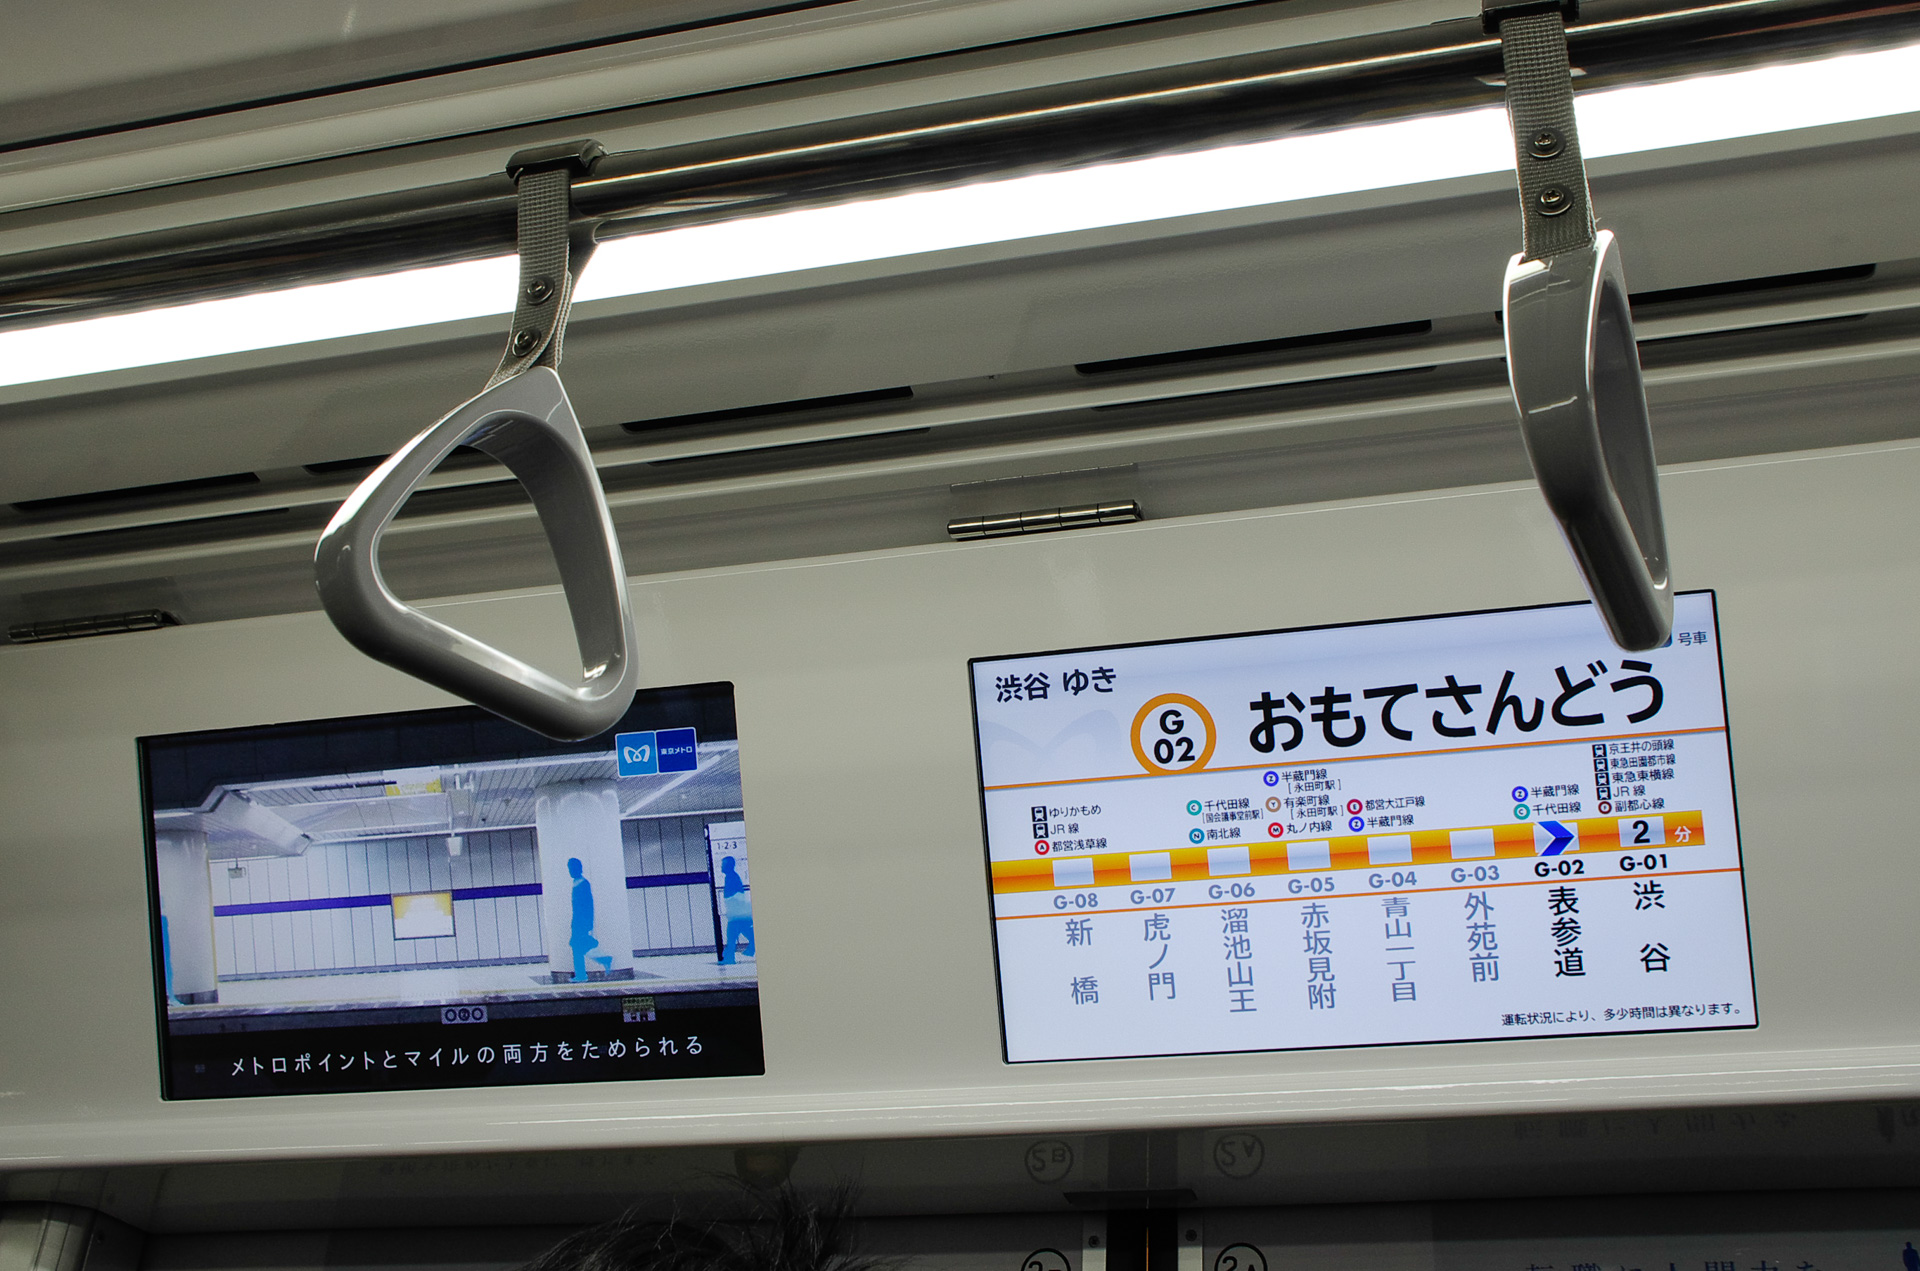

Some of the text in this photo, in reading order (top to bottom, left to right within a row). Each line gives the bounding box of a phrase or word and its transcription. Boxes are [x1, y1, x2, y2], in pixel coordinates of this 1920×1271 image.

[1678, 631, 1708, 646] 号車
[995, 666, 1117, 703] 渋谷 ゆき
[1249, 659, 1664, 753] おもてさんどう
[1159, 709, 1185, 735] G
[660, 746, 692, 755] 東京メトロ
[1153, 737, 1196, 764] 02
[1609, 738, 1674, 755] 京王井の頭線
[1610, 753, 1676, 769] 東急田園都市線
[1281, 768, 1328, 783] 半蔵門線
[1611, 768, 1675, 784] 東急東横線
[1530, 783, 1580, 798] 半蔵門線
[1612, 784, 1646, 798] JR 線
[1204, 797, 1250, 812] 千代田線
[1283, 794, 1330, 809] 有楽町線
[1365, 795, 1426, 812] 都営大江戸線
[1532, 801, 1581, 816] 千代田線
[1614, 797, 1665, 813] 副都心線
[1049, 804, 1102, 818] ゆりかもめ
[1050, 822, 1080, 835] JR 線
[1286, 820, 1333, 834] 丸ノ内線
[1366, 814, 1415, 829] 半蔵門線
[1206, 827, 1242, 841] 南北線
[1631, 820, 1692, 844] 2 分
[1052, 837, 1108, 853] 都営浅草線
[1534, 859, 1585, 877] G-02
[1619, 853, 1668, 872] G-01
[1368, 871, 1417, 889] G-04
[1450, 865, 1500, 883] G-03
[1208, 883, 1256, 900] G-06
[1287, 877, 1335, 894] G-05
[1053, 892, 1099, 910] G-08
[1130, 888, 1176, 905] G-07
[1547, 886, 1586, 979] 表参道
[1633, 880, 1671, 973] 渋谷
[1463, 891, 1500, 983] 外苑前
[1143, 912, 1176, 1001] 虎ノ門
[1301, 902, 1337, 1010] 赤坂見附
[1381, 896, 1417, 1002] 青山一丁目
[1065, 918, 1100, 1005] 新橋
[1220, 908, 1257, 1013] 溜池山王
[1501, 1002, 1741, 1027] 運転状況により、多少時間は異なります。
[231, 1036, 702, 1076] メトロポイントとマイルの両方をためられる
